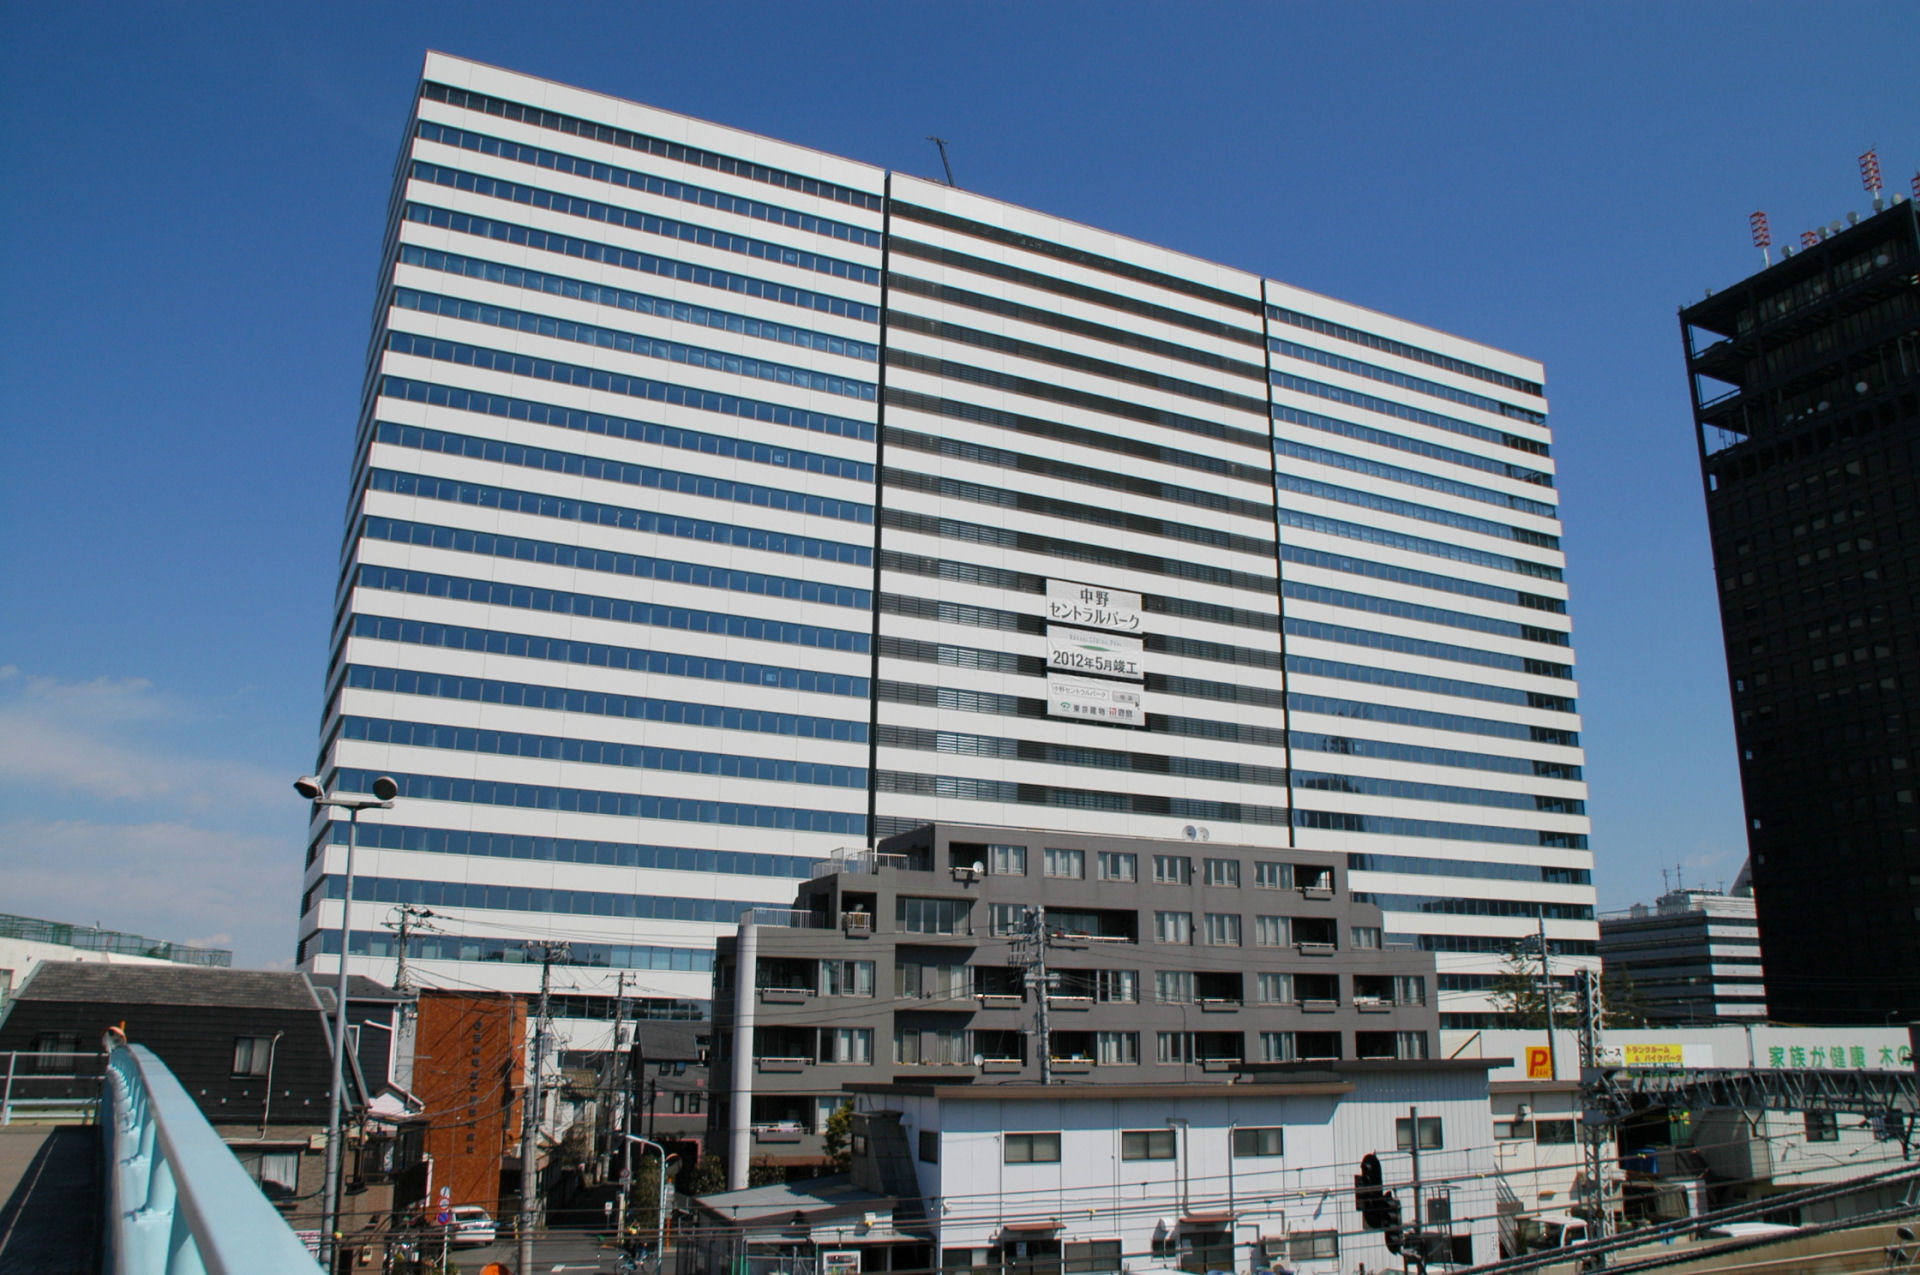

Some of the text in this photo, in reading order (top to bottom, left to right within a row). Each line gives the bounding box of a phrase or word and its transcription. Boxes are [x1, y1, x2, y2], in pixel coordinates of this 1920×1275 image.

[1080, 588, 1109, 607] 中野
[1050, 601, 1140, 630] セントラルパーク
[1053, 650, 1138, 675] 2012年5月竣工
[1529, 1049, 1548, 1077] P
[1768, 1045, 1866, 1069] 家族が健康
